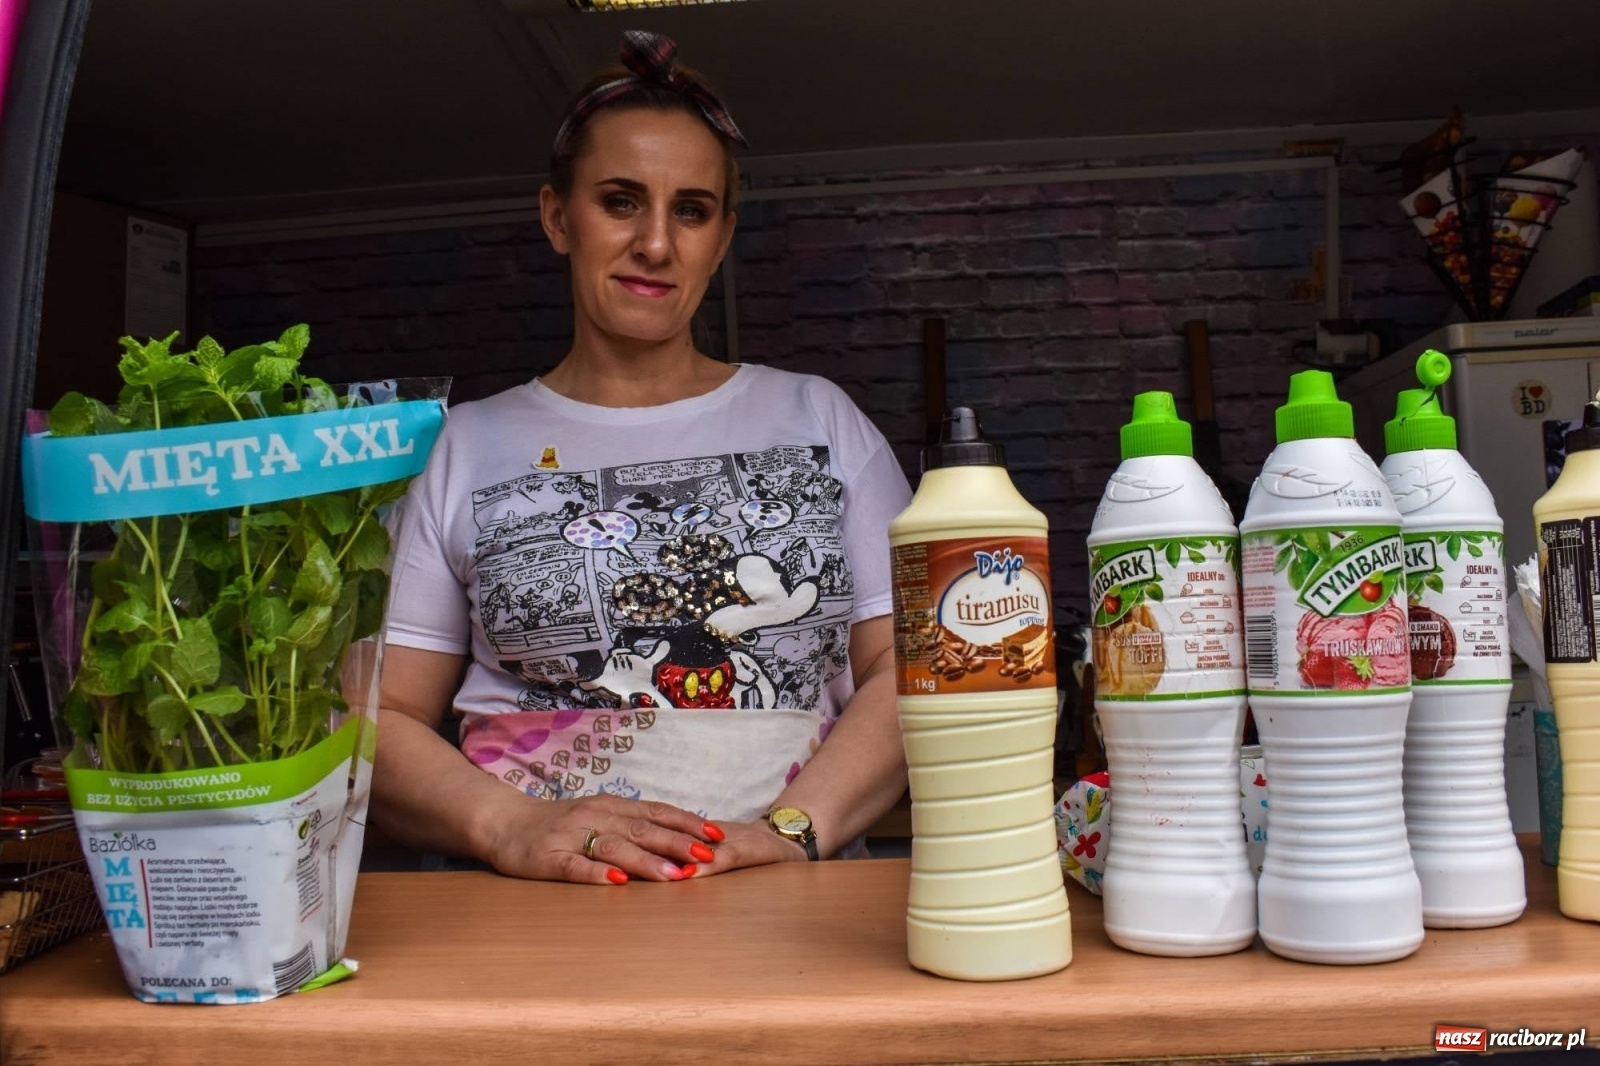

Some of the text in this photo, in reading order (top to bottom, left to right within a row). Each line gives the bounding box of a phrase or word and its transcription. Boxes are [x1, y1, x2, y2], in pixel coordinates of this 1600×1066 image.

[1520, 387, 1528, 400] I
[1521, 400, 1545, 415] BD
[88, 418, 414, 496] MIĘTA XXL
[1339, 535, 1364, 552] 1936
[975, 548, 1023, 585] Dijo
[1311, 542, 1400, 605] TYMBARK
[1466, 564, 1492, 575] IDEALNY
[1187, 571, 1217, 582] IDEALNY
[956, 587, 1039, 620] tiramisu
[1417, 623, 1439, 631] SMAKU
[1116, 634, 1131, 647] SOS
[1128, 646, 1162, 663] TOFFI
[109, 772, 241, 791] WYPRODUKOWANO
[86, 785, 272, 807] BEZ UŻYCIA PESTYCYDÓW
[89, 832, 157, 853] Baziółka
[141, 976, 232, 988] POLECANA DO:
